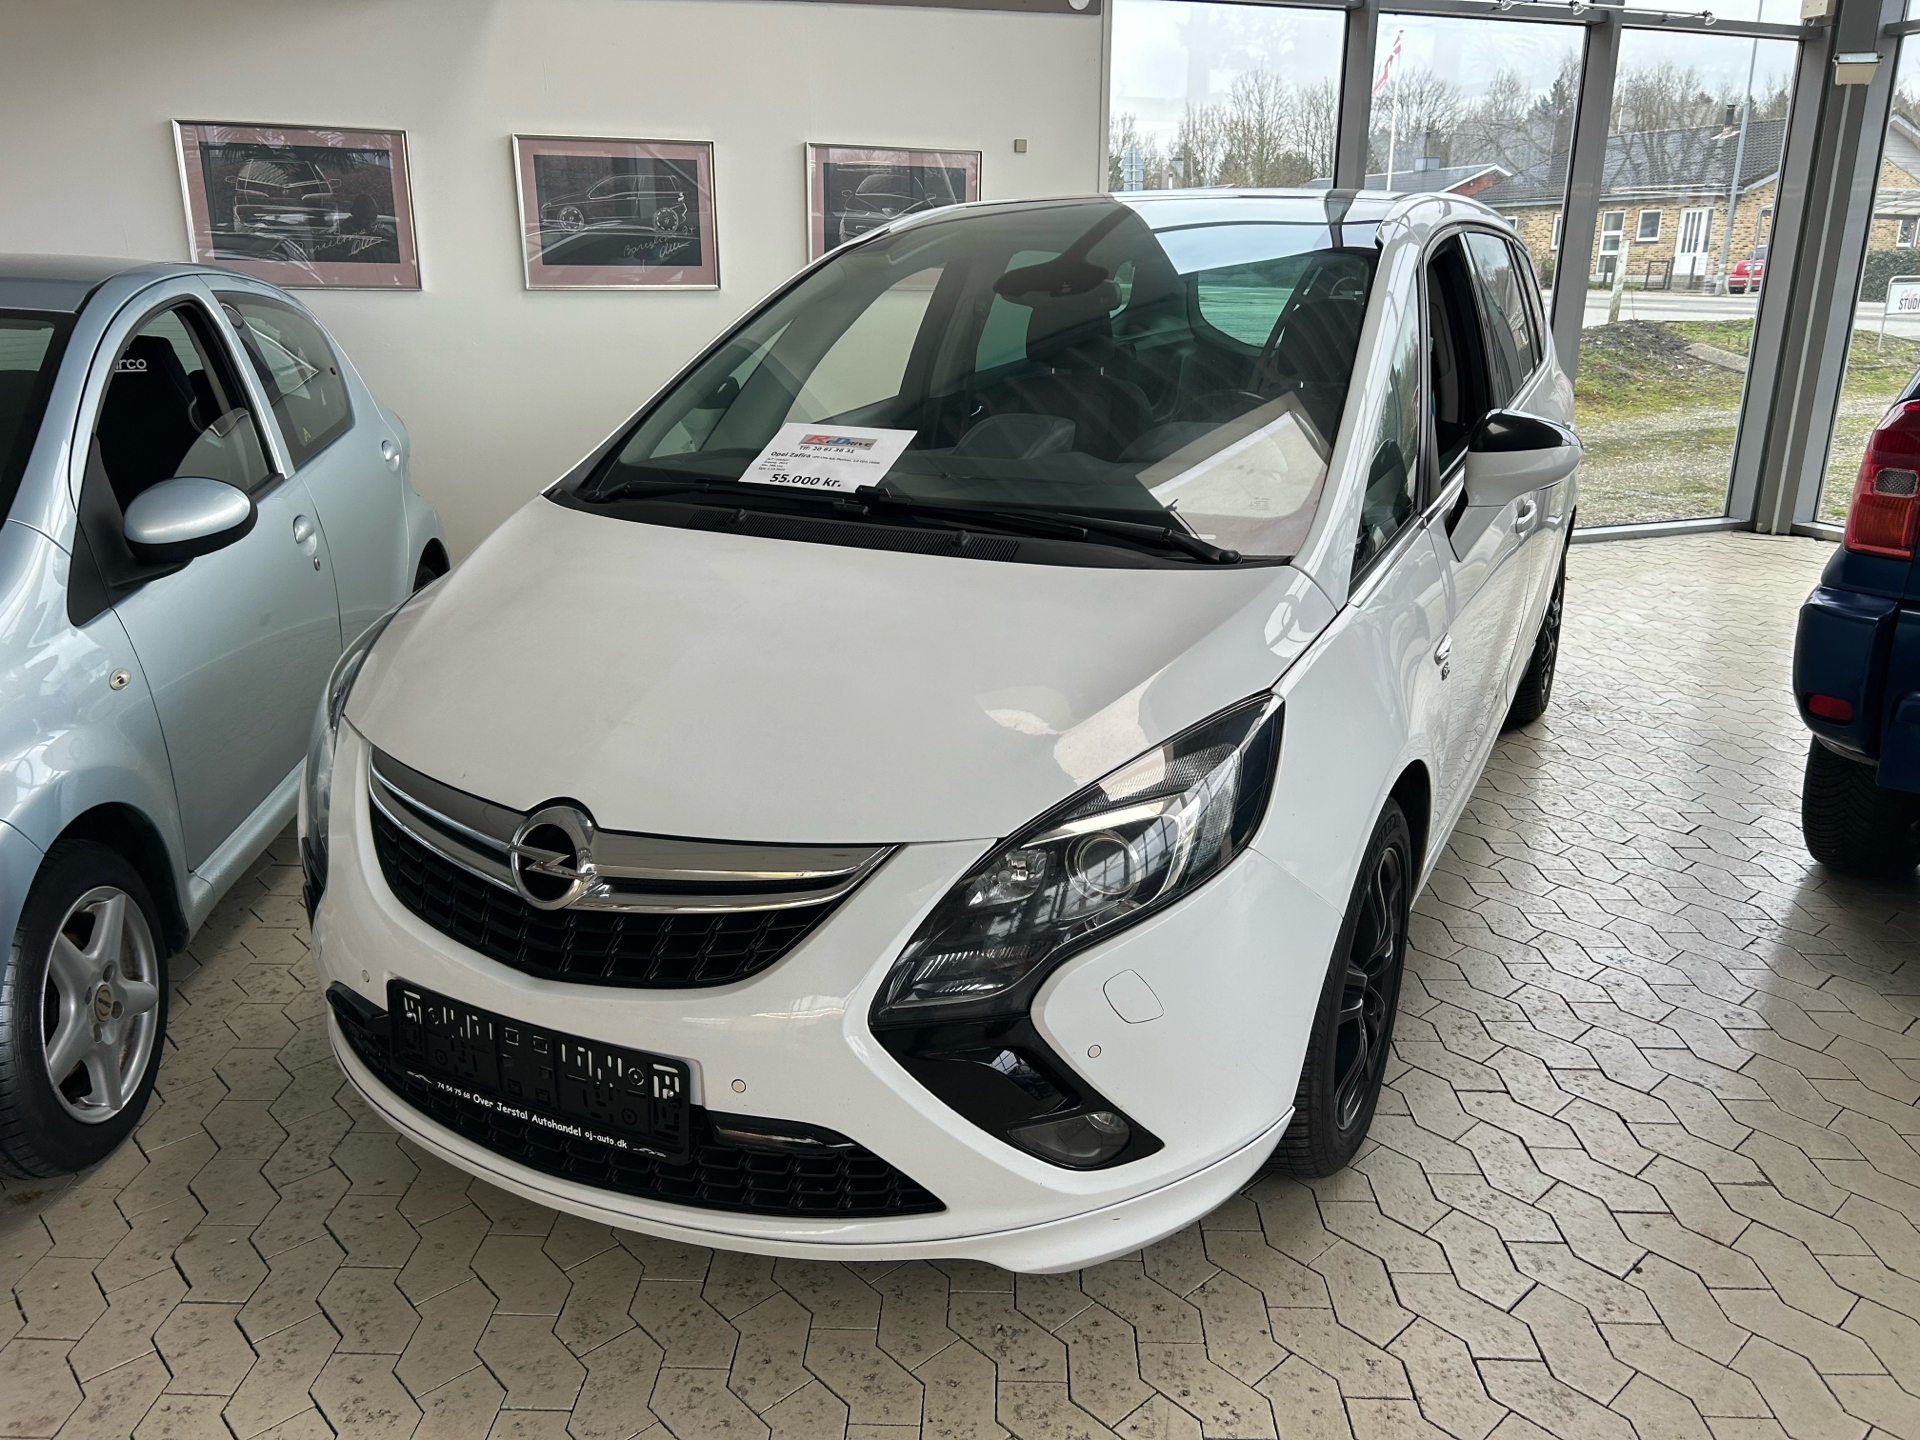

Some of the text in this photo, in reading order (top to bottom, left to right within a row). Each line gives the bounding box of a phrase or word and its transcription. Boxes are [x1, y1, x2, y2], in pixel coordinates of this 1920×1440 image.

[769, 473, 842, 487] 55.000 kr.
[437, 1081, 445, 1090] 74
[454, 1088, 462, 1096] 75
[463, 1091, 471, 1099] 68
[473, 1094, 494, 1108] Over
[496, 1101, 528, 1120] Jerstal
[531, 1114, 582, 1137] Autohandel
[584, 1131, 628, 1149] oj-auto.dk
